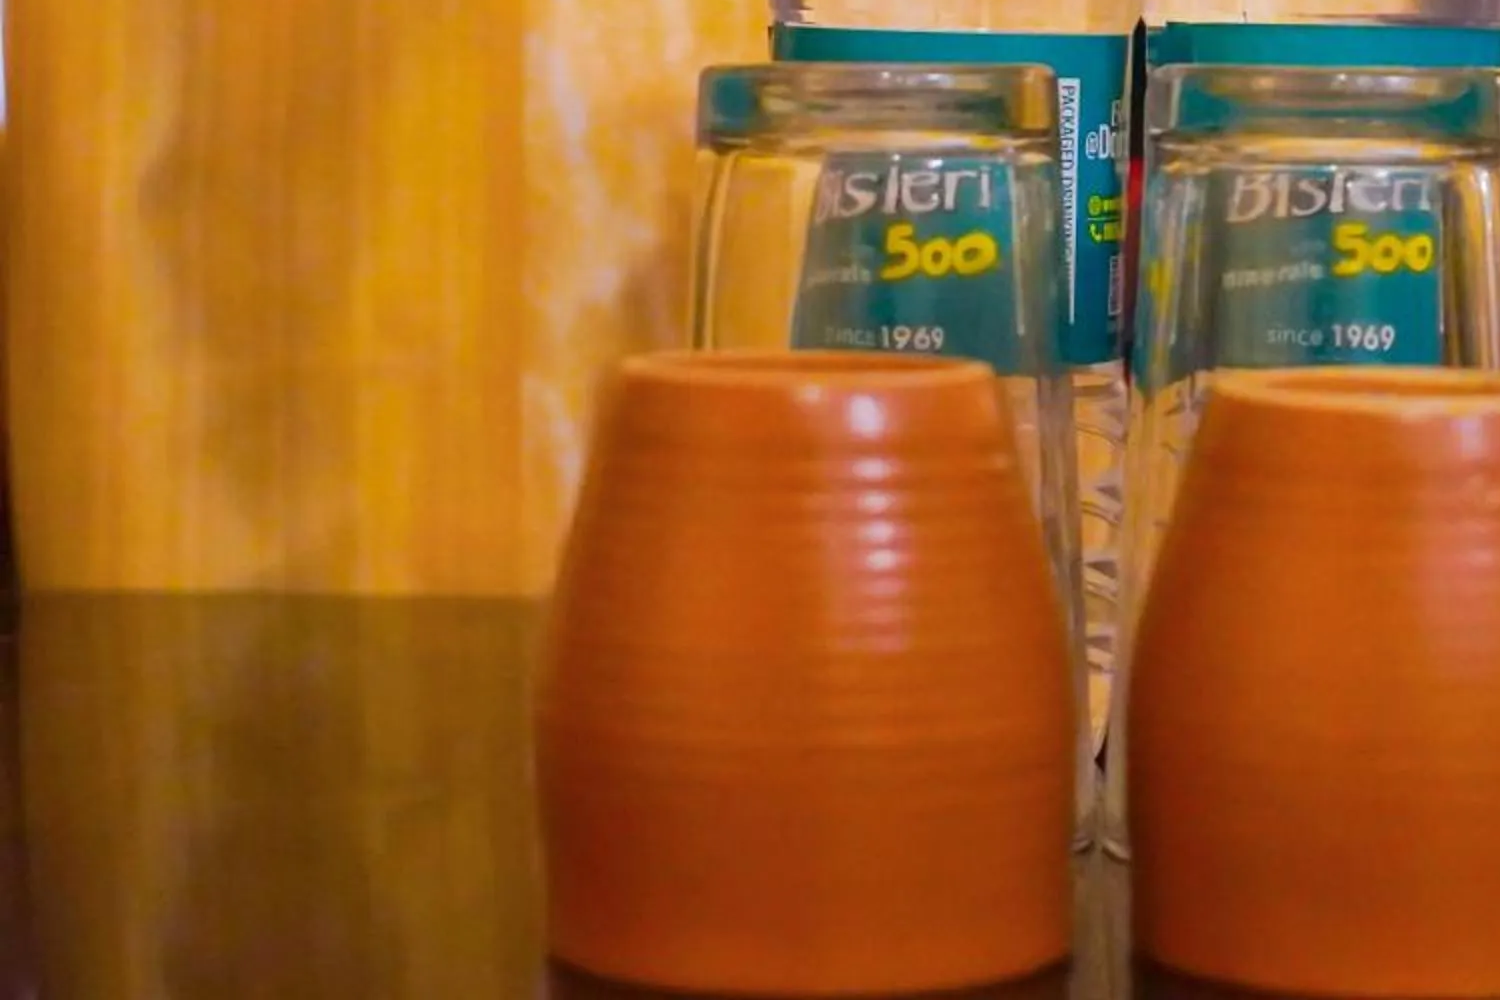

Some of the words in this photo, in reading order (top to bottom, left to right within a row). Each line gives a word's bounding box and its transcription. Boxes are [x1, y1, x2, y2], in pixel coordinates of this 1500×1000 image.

[1060, 85, 1076, 171] PACKAGED
[880, 222, 998, 281] 500
[1332, 222, 1434, 277] 500
[881, 325, 945, 350] 1969
[1267, 327, 1324, 346] since
[1332, 325, 1396, 351] 1969
